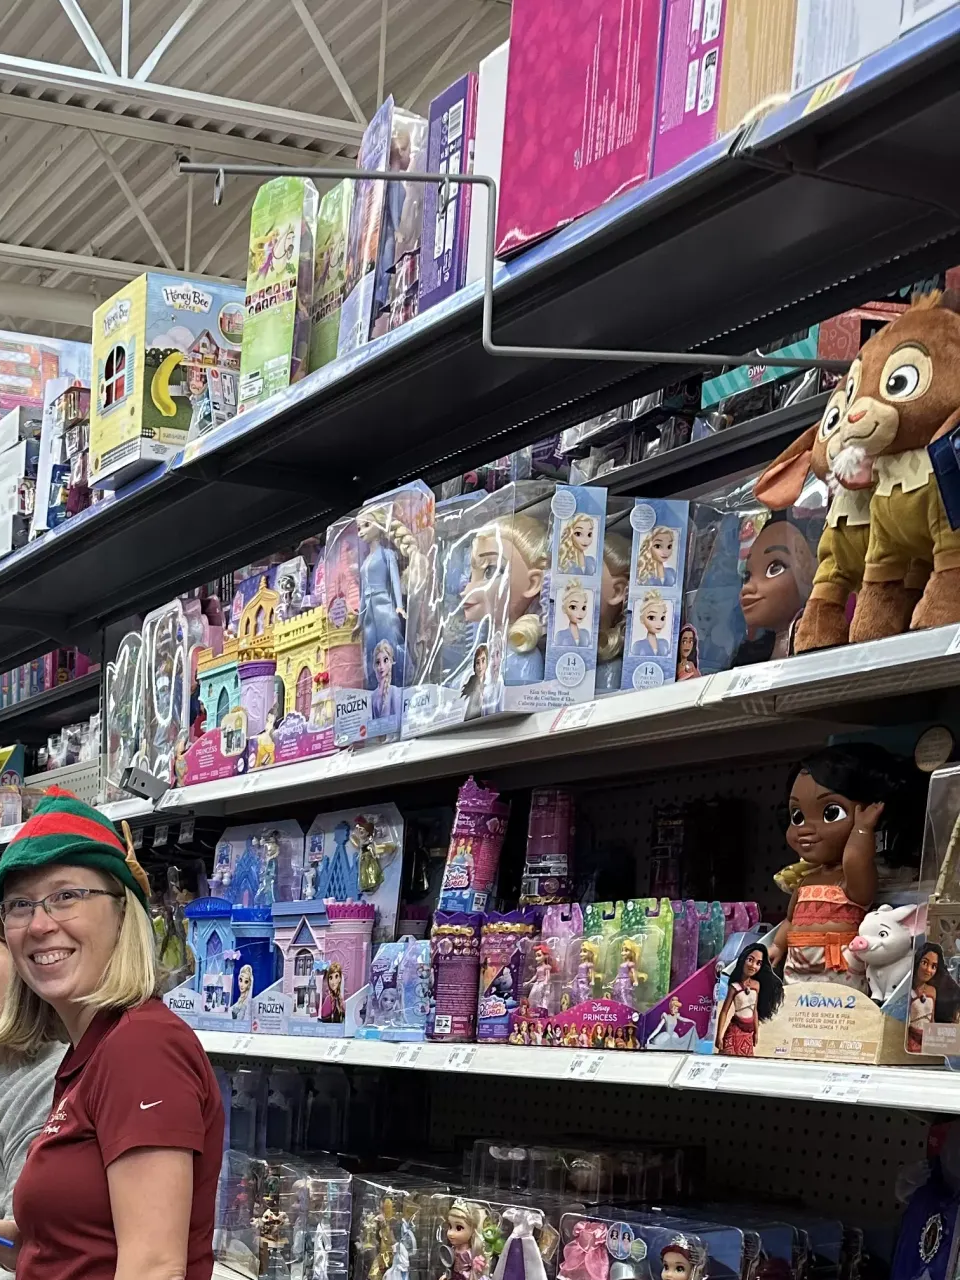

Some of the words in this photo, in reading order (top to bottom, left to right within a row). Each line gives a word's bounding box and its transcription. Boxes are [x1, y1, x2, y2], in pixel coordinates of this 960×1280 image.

[164, 288, 191, 305] Honey
[192, 290, 209, 308] Bee
[566, 657, 577, 666] 14
[644, 666, 654, 676] 14
[336, 698, 368, 718] FROZEN
[169, 998, 195, 1010] FROZEN
[591, 1001, 611, 1013] Disney
[794, 993, 843, 1009] MOANA
[844, 995, 857, 1009] 2
[258, 1002, 285, 1014] FROZEN
[582, 1013, 618, 1022] PRINCESS
